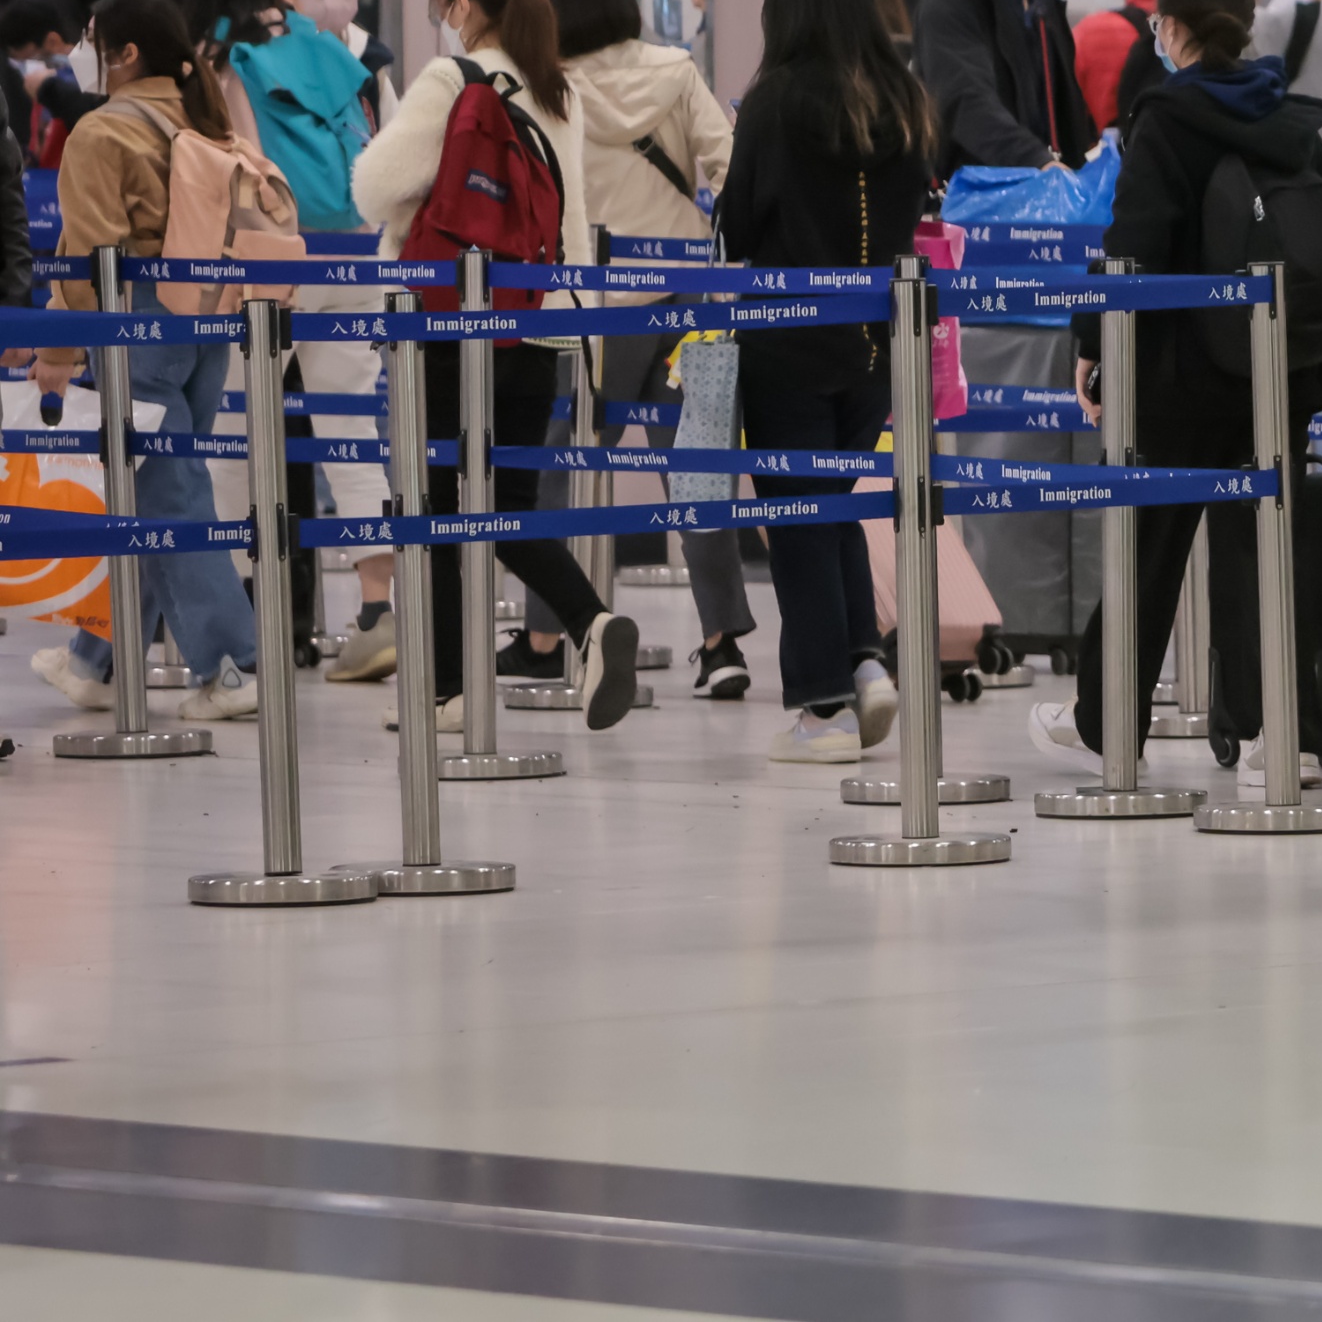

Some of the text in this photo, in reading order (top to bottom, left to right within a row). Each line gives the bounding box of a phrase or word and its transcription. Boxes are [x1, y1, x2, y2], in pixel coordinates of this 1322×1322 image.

[1010, 227, 1064, 241] Immigration
[632, 242, 663, 257] 入境處
[1028, 245, 1063, 262] 入境處
[139, 262, 170, 279] 入境處
[190, 262, 246, 278] Immigration
[325, 265, 357, 281] 入境處
[378, 264, 435, 280] Immigration
[551, 269, 872, 289] 入境處 Immigration 入境處 Immigration
[967, 282, 1248, 312] 入境處 Immigration 入境處
[117, 321, 163, 340] 入境處
[331, 317, 388, 337] 入境處
[426, 315, 517, 334] Immigration
[648, 308, 697, 328] 入境處
[730, 302, 818, 323] Immigration
[1022, 389, 1077, 405] Immigration
[627, 406, 659, 424] 入境處
[1026, 412, 1060, 428] 入境處
[25, 434, 358, 460] Immigration 入境處 Immigration 入境處
[554, 447, 875, 471] 入境處 Immigration 入境處 Immigration
[956, 462, 1051, 482] 入境處 Immigration
[972, 476, 1253, 509] 入境處 Immigration 入境處
[128, 501, 818, 549] 入境處 入境處 Immigration 入境處 Immigration
